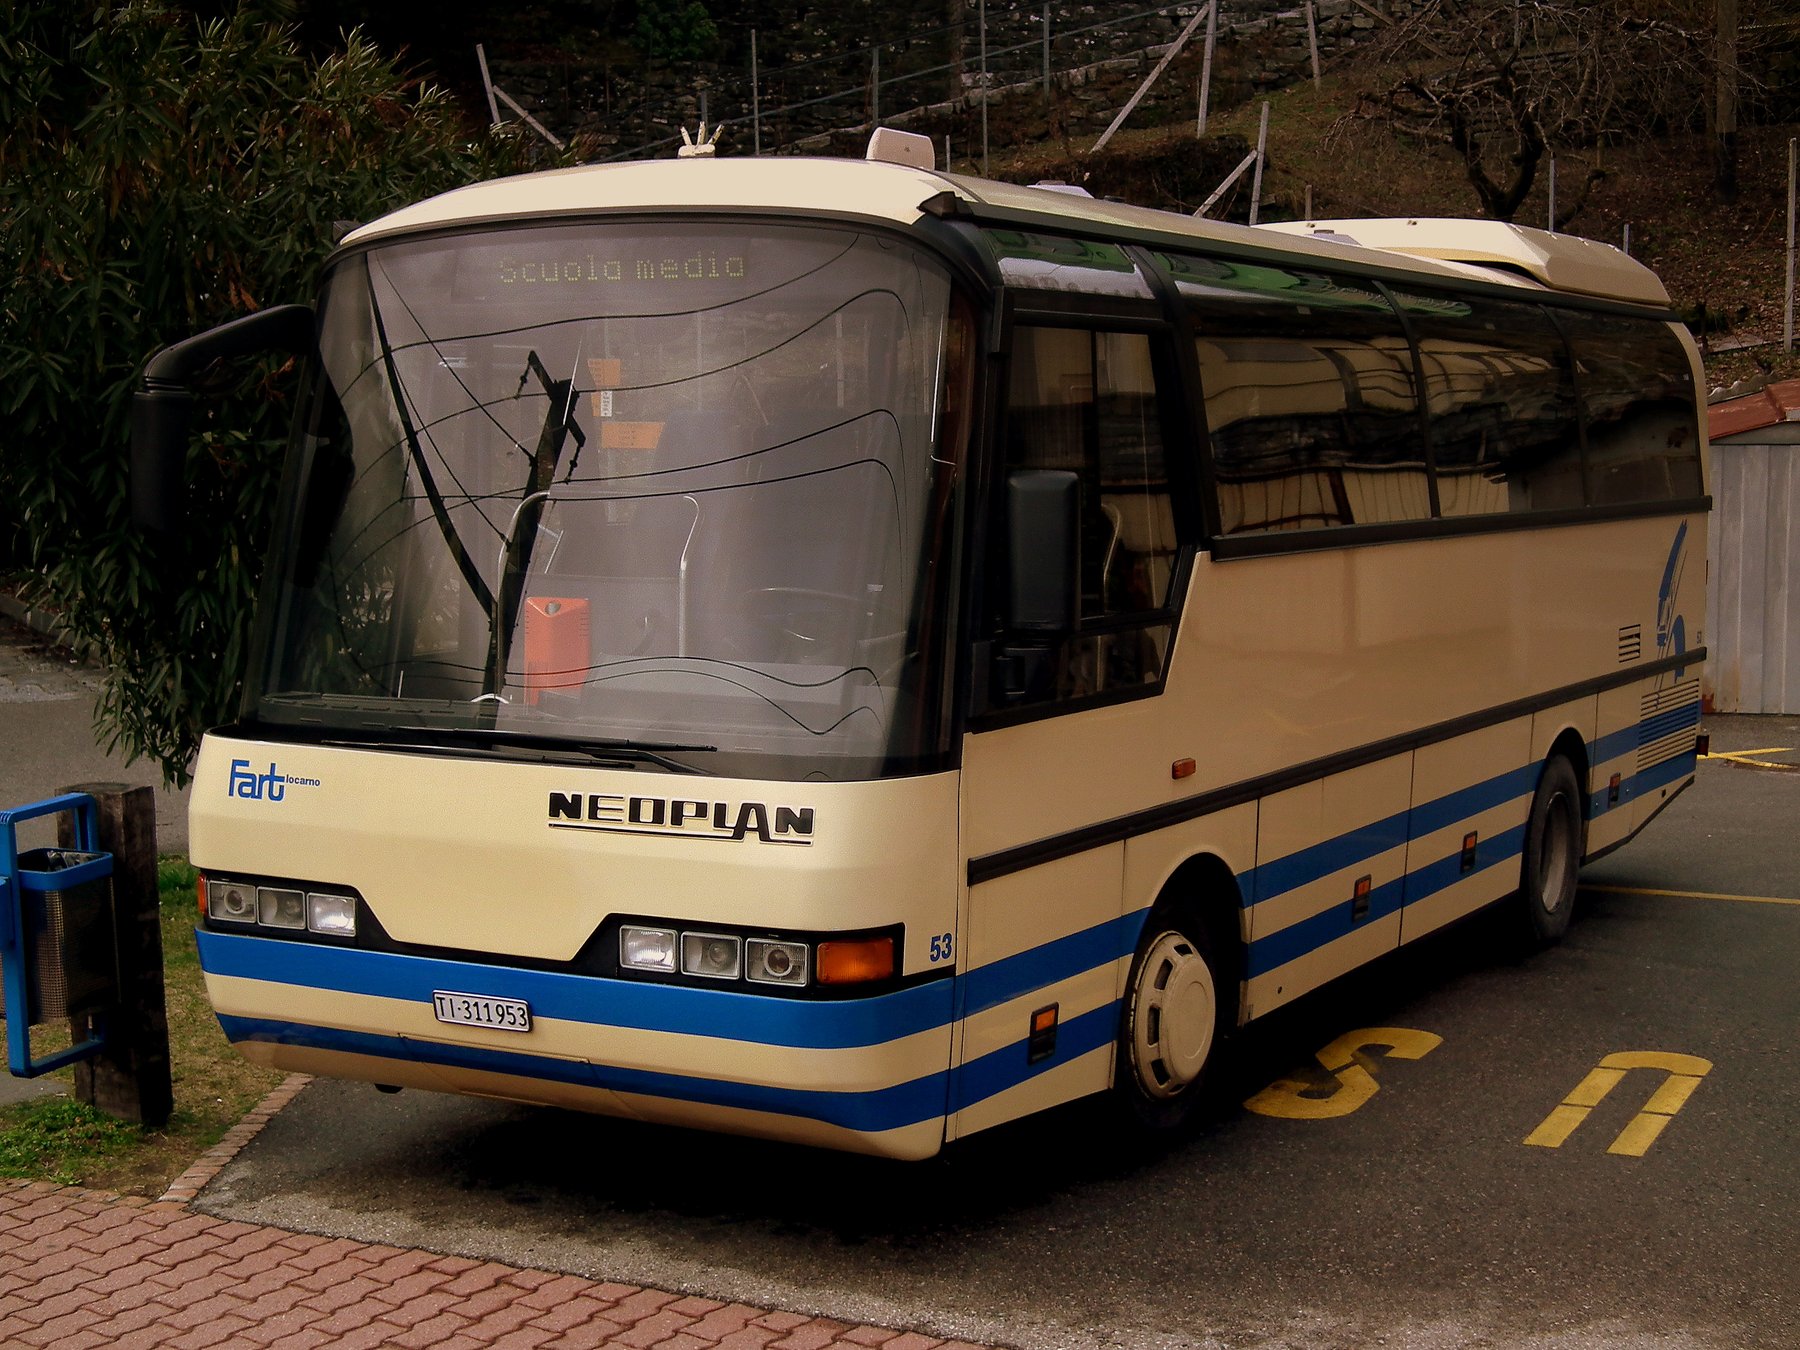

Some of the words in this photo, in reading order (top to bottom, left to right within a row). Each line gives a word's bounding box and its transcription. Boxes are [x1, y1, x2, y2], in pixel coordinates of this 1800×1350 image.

[500, 254, 621, 283] Scuola
[636, 251, 744, 279] media
[228, 759, 285, 801] Fart
[286, 774, 320, 786] locarno
[549, 792, 813, 845] NEOPLAN
[930, 932, 953, 962] 53
